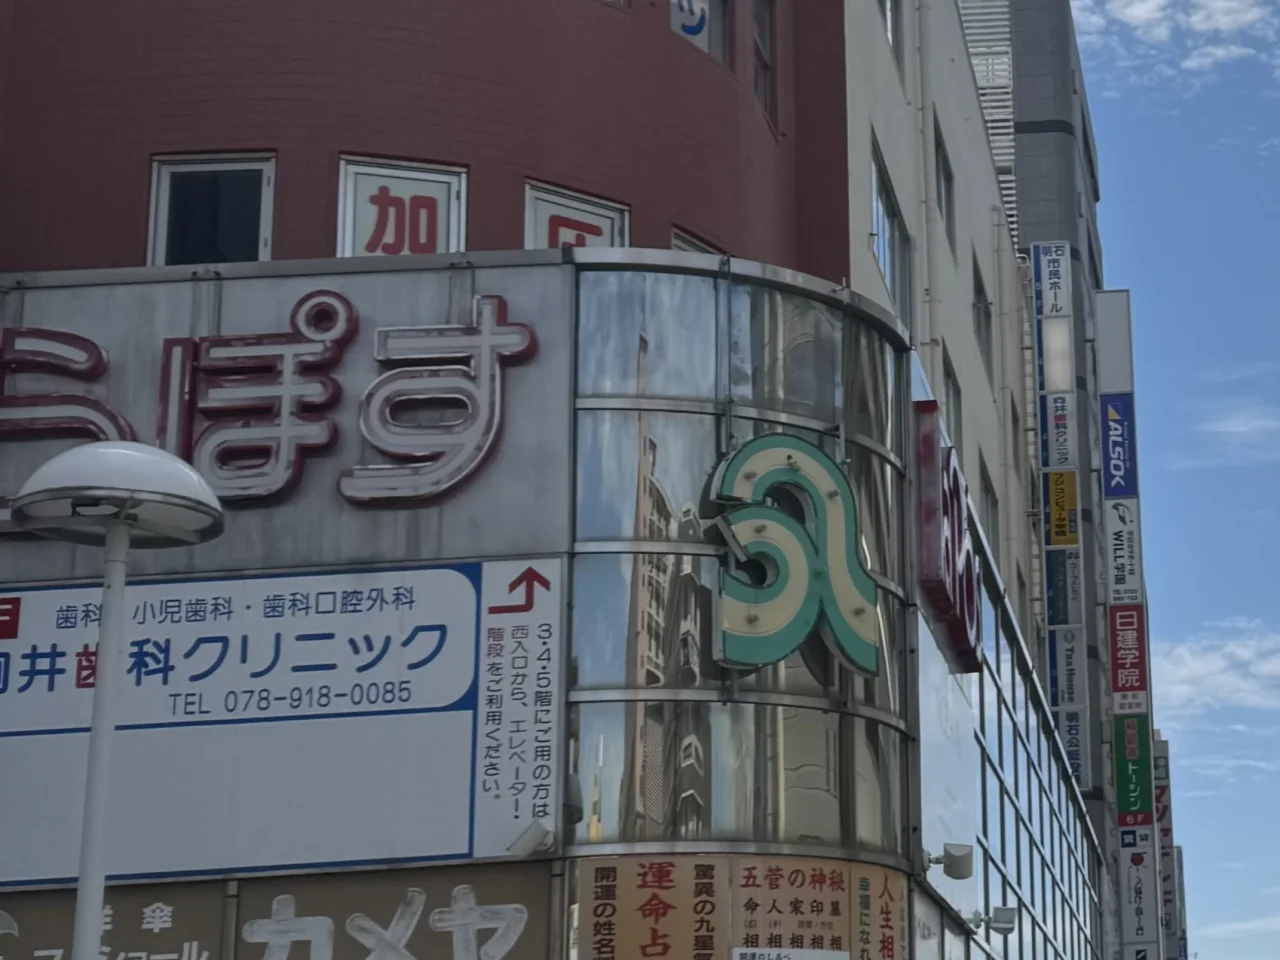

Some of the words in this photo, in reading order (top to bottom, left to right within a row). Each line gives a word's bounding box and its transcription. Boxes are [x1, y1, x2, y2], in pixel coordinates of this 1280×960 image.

[1107, 421, 1125, 488] ALSOK
[1112, 530, 1127, 585] WILL学園
[1115, 611, 1140, 688] 日建学院
[169, 692, 211, 716] TEL
[224, 680, 413, 714] 078-918-0085
[481, 626, 506, 800] 階段をご利用ください。
[531, 622, 554, 819] 3・4・5階にご用の方は
